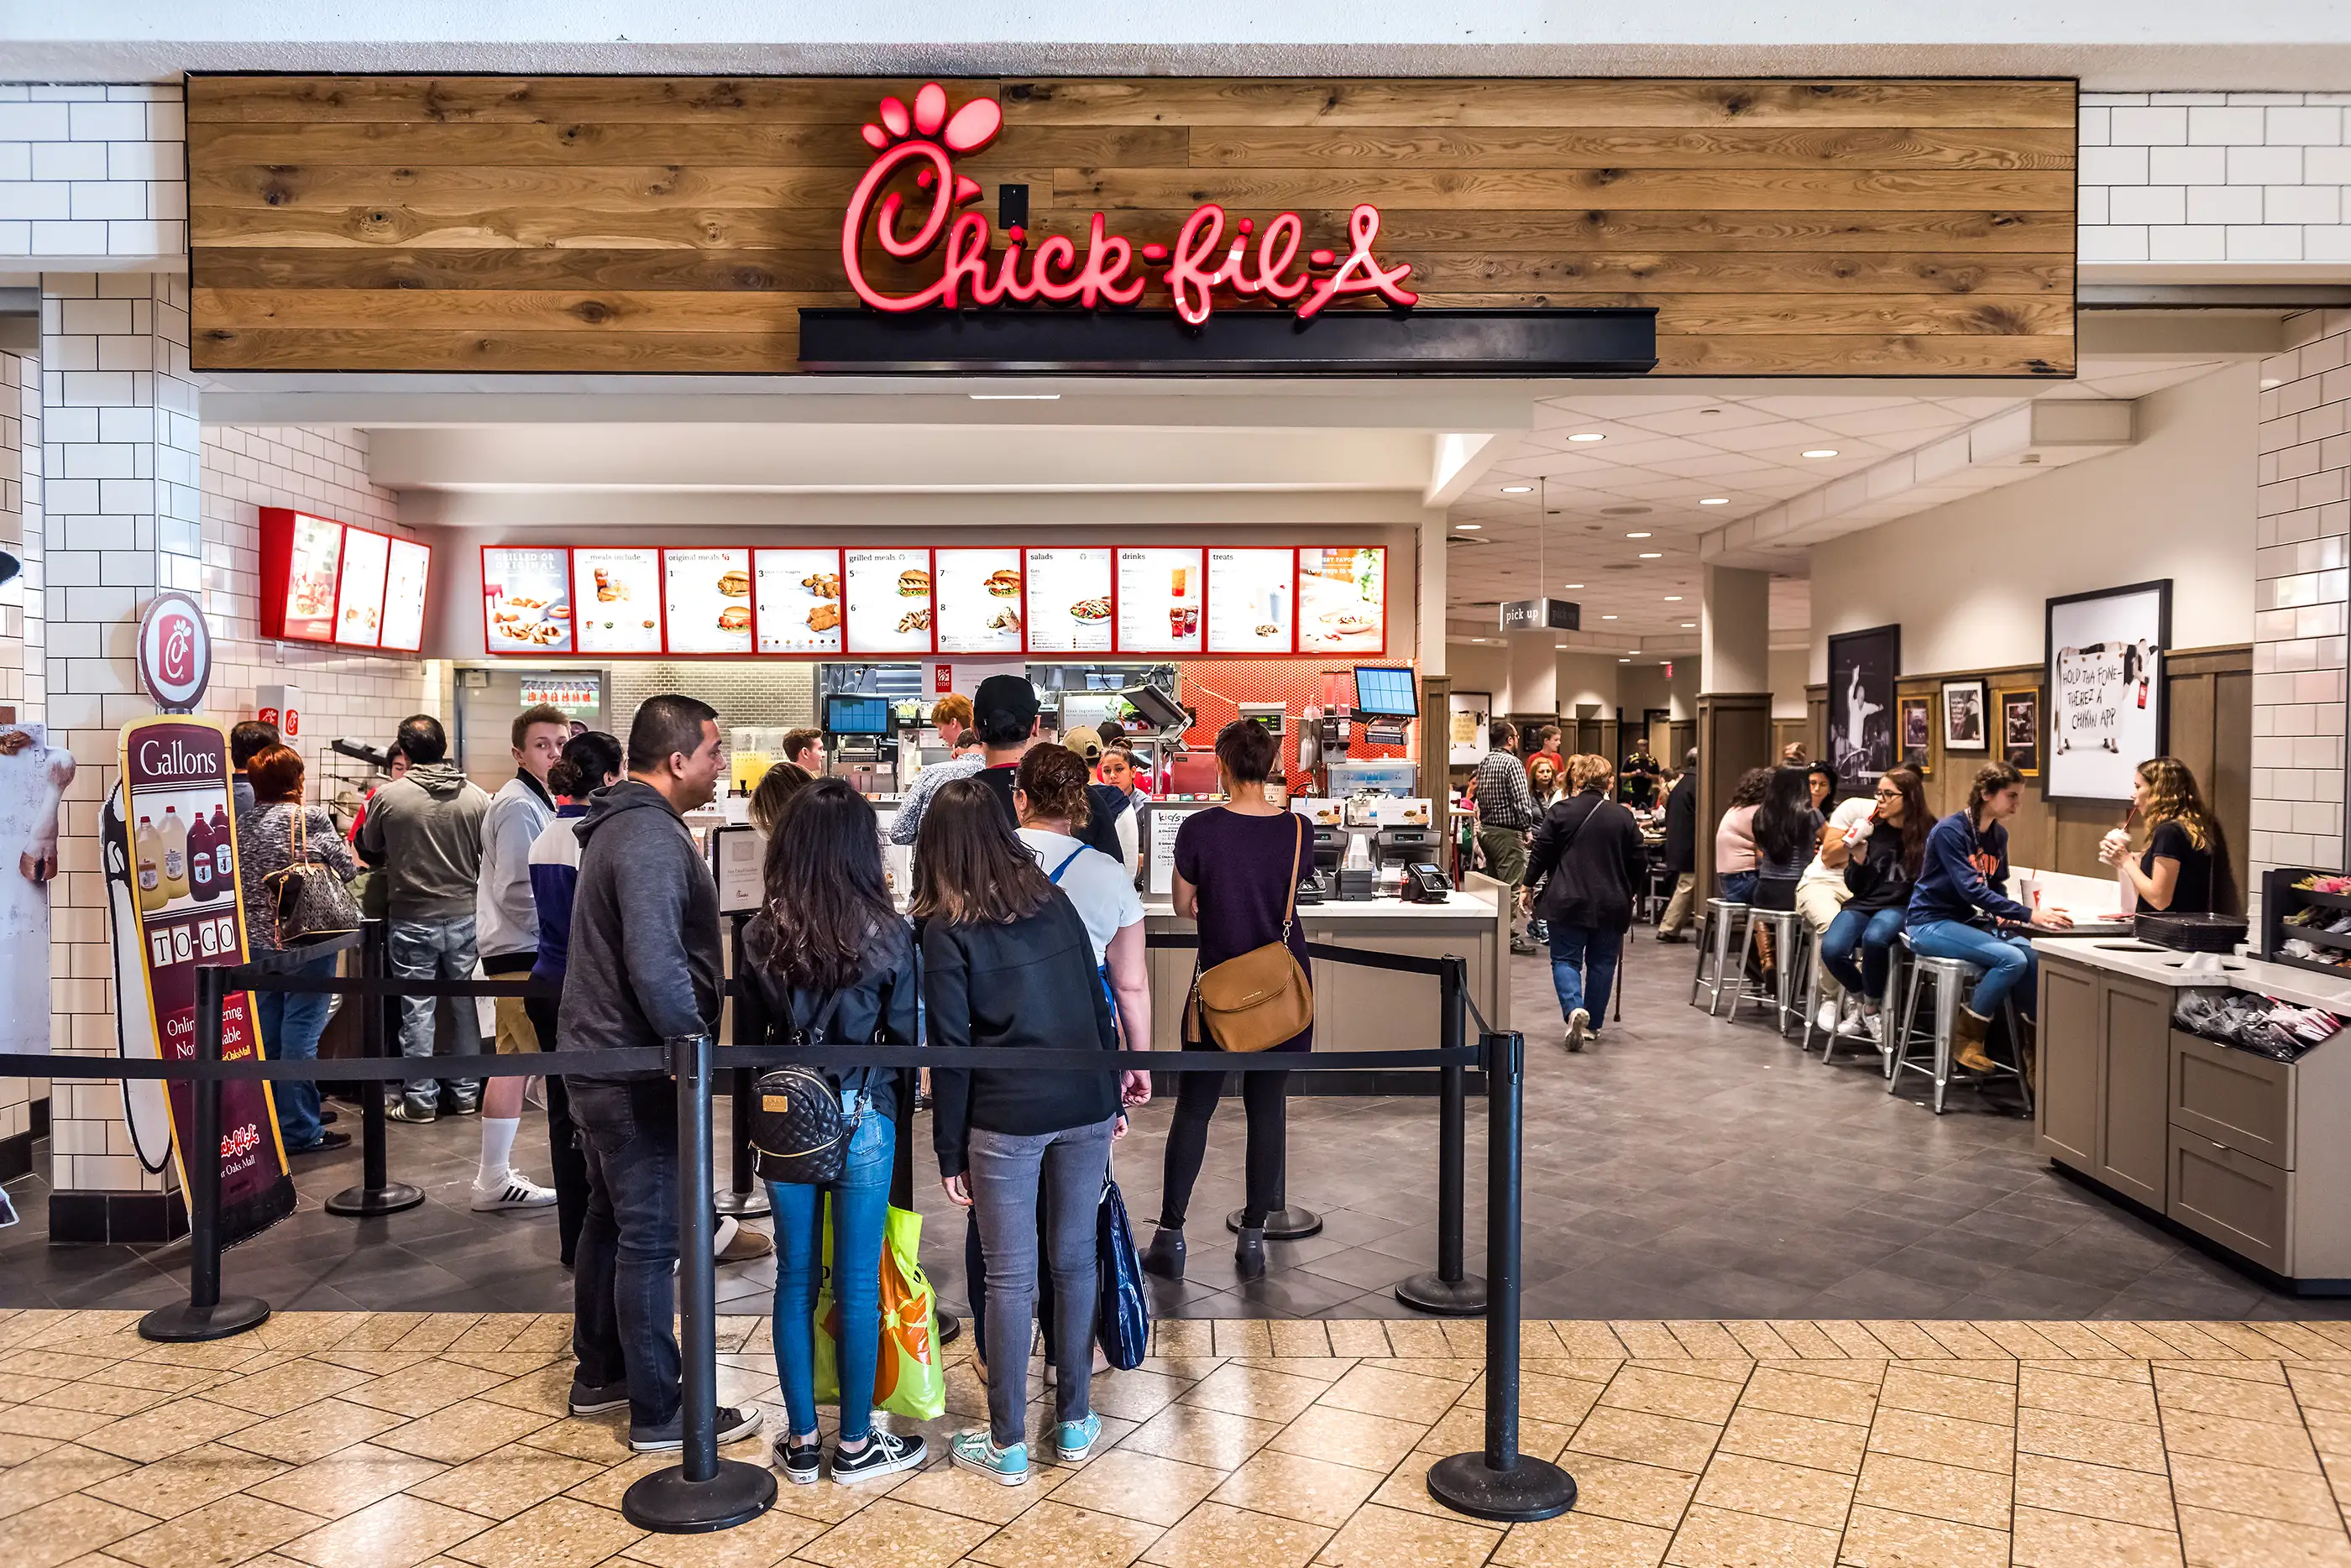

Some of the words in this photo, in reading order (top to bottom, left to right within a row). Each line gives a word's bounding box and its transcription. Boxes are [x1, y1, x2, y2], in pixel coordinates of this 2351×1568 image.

[842, 139, 1419, 327] Chick-fil-A
[668, 553, 696, 563] original
[698, 553, 720, 562] meals
[849, 553, 872, 563] grilled
[874, 553, 896, 562] meals
[1030, 552, 1054, 561] salads
[1122, 552, 1146, 561] drinks
[849, 569, 855, 578] 5
[940, 569, 946, 578] 7
[851, 604, 856, 612] 6
[940, 604, 946, 612] 8
[1506, 608, 1524, 624] pick
[1526, 609, 1539, 621] up
[2063, 668, 2081, 685] HOLD
[2083, 670, 2095, 685] THA
[2067, 688, 2094, 708] THEREZ
[2097, 688, 2102, 705] A
[2071, 709, 2097, 729] CHIKIN
[2100, 708, 2116, 729] APP
[140, 740, 217, 776] Gallons
[1159, 812, 1181, 823] kids
[154, 923, 234, 962] TO-GO
[167, 1016, 195, 1037] Onlin
[223, 1006, 243, 1021] ering
[176, 1040, 195, 1059] No
[221, 1123, 260, 1158] ck-fil-A
[226, 1162, 242, 1175] Oaks
[242, 1154, 255, 1168] Mall
